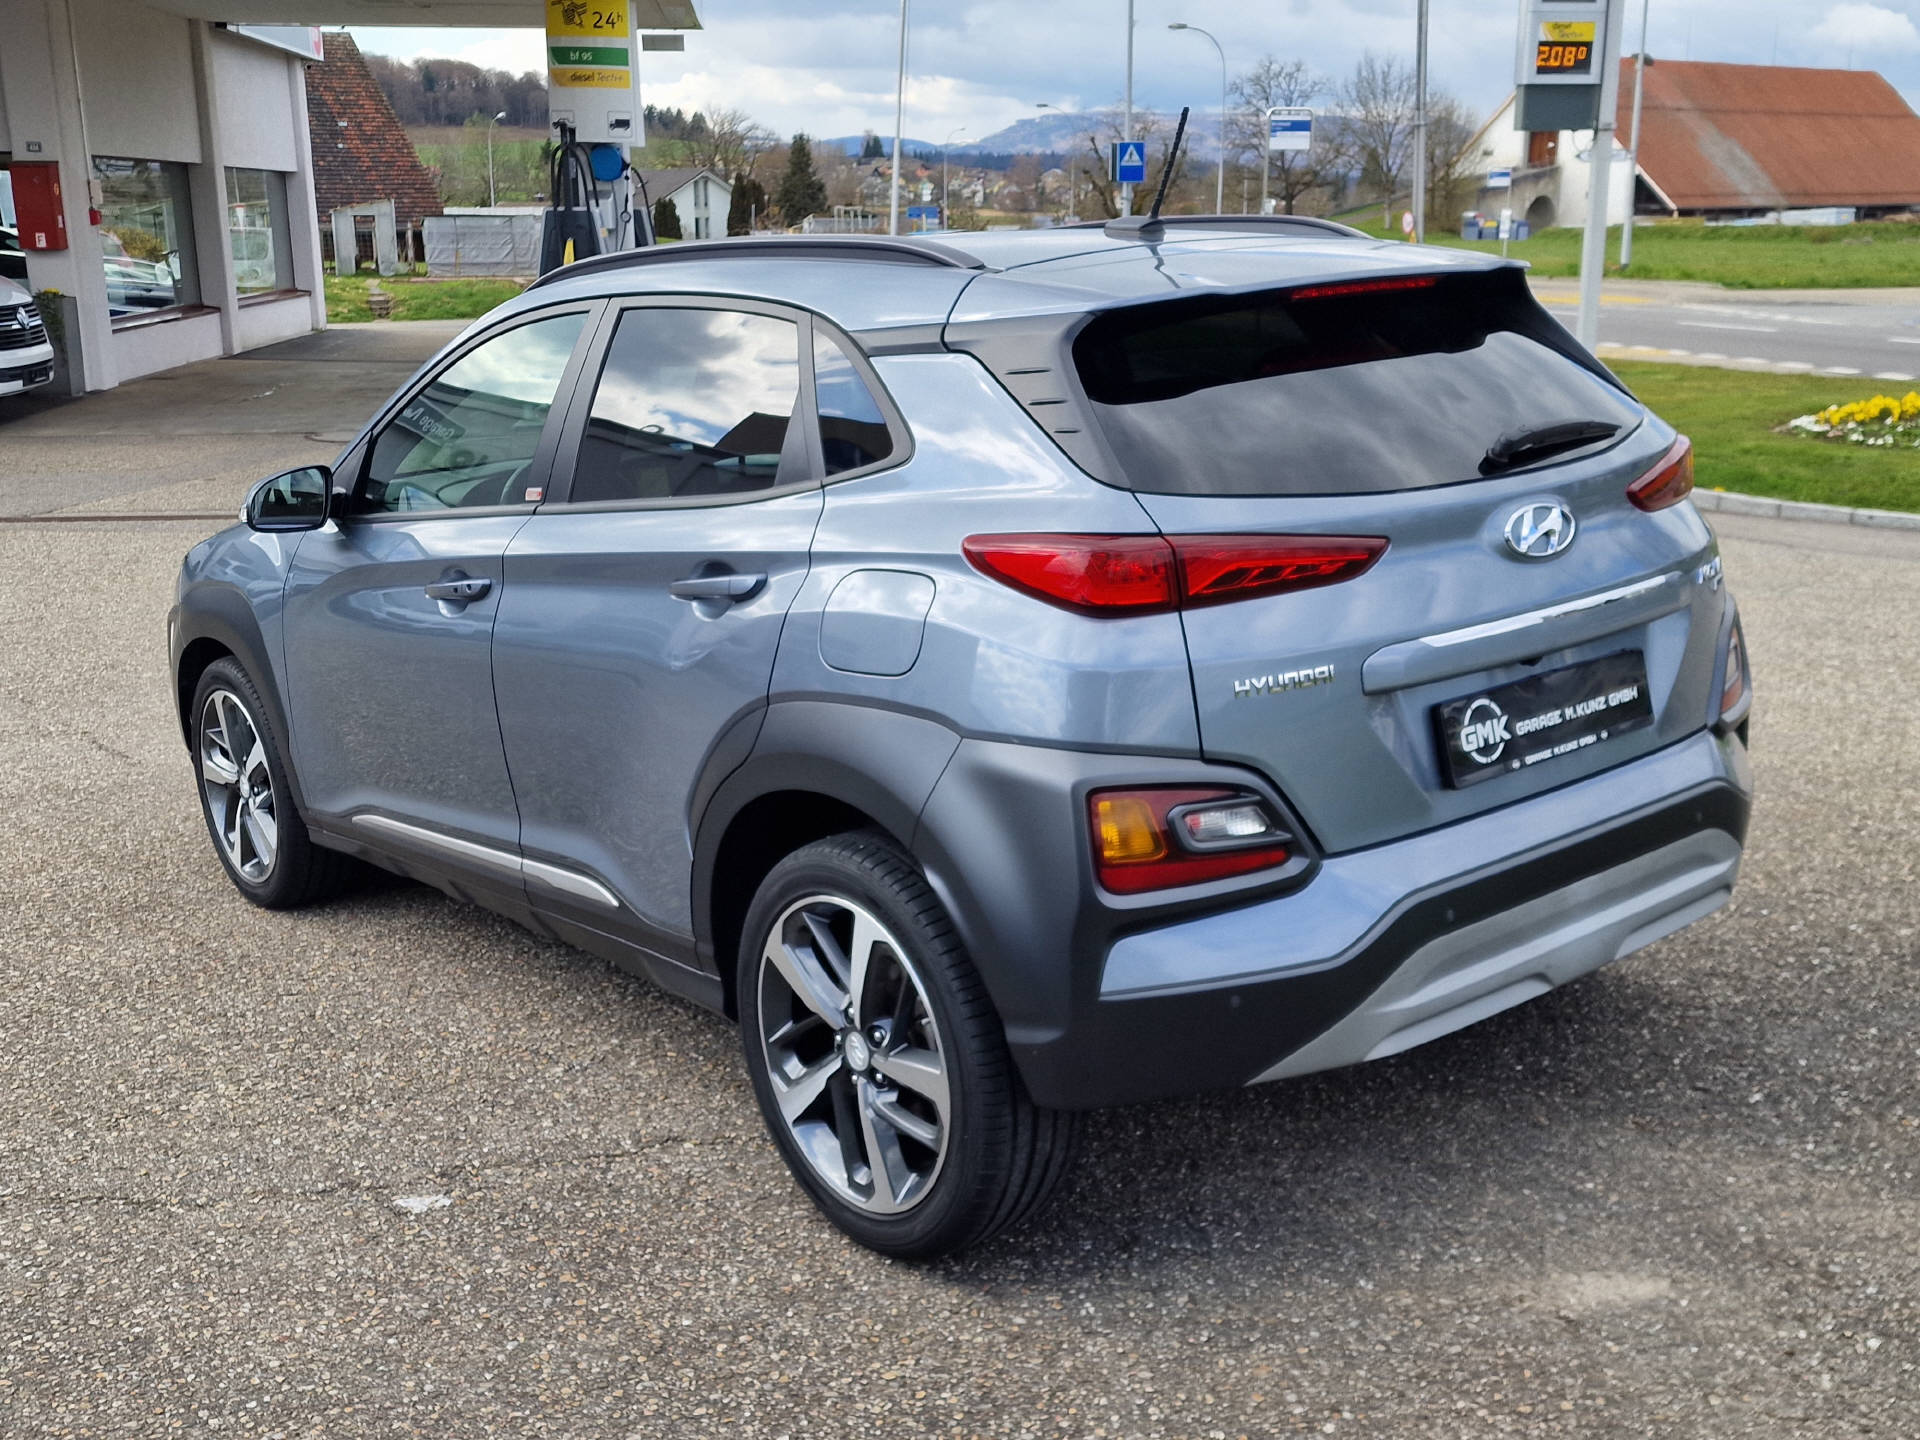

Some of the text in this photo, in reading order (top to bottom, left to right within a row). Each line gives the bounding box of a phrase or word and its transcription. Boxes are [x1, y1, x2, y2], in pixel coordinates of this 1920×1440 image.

[591, 11, 624, 29] 24h
[570, 72, 595, 82] diesel
[1234, 664, 1336, 698] HYUNDAI
[1515, 709, 1563, 736] GARAGE
[1608, 685, 1639, 707] GMBH
[1460, 714, 1512, 752] GMK
